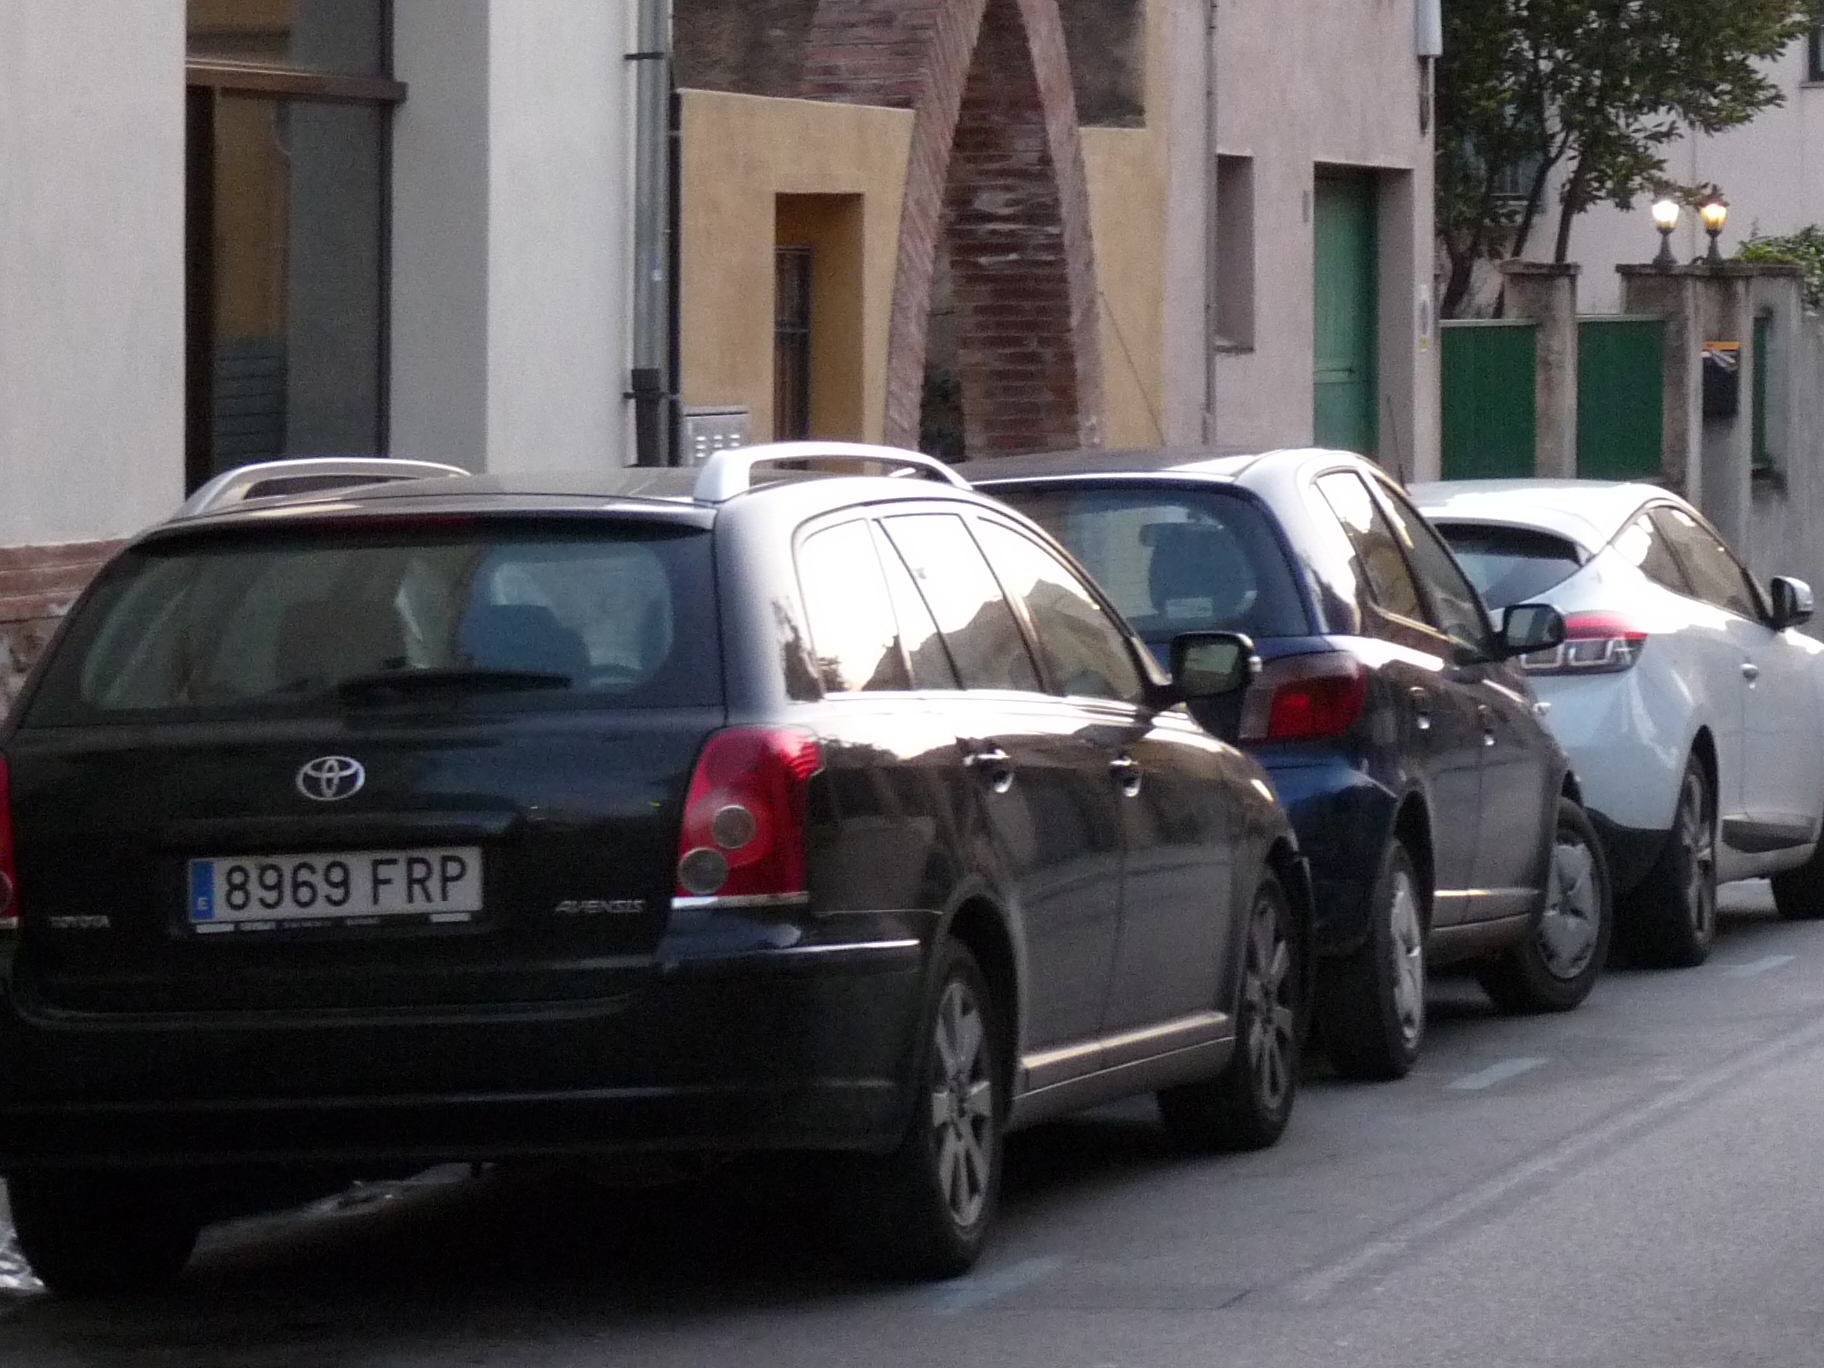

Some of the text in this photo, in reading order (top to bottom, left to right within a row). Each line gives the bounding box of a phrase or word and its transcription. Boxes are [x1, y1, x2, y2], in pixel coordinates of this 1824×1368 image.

[225, 854, 467, 911] 8969 FRP
[197, 897, 207, 910] E
